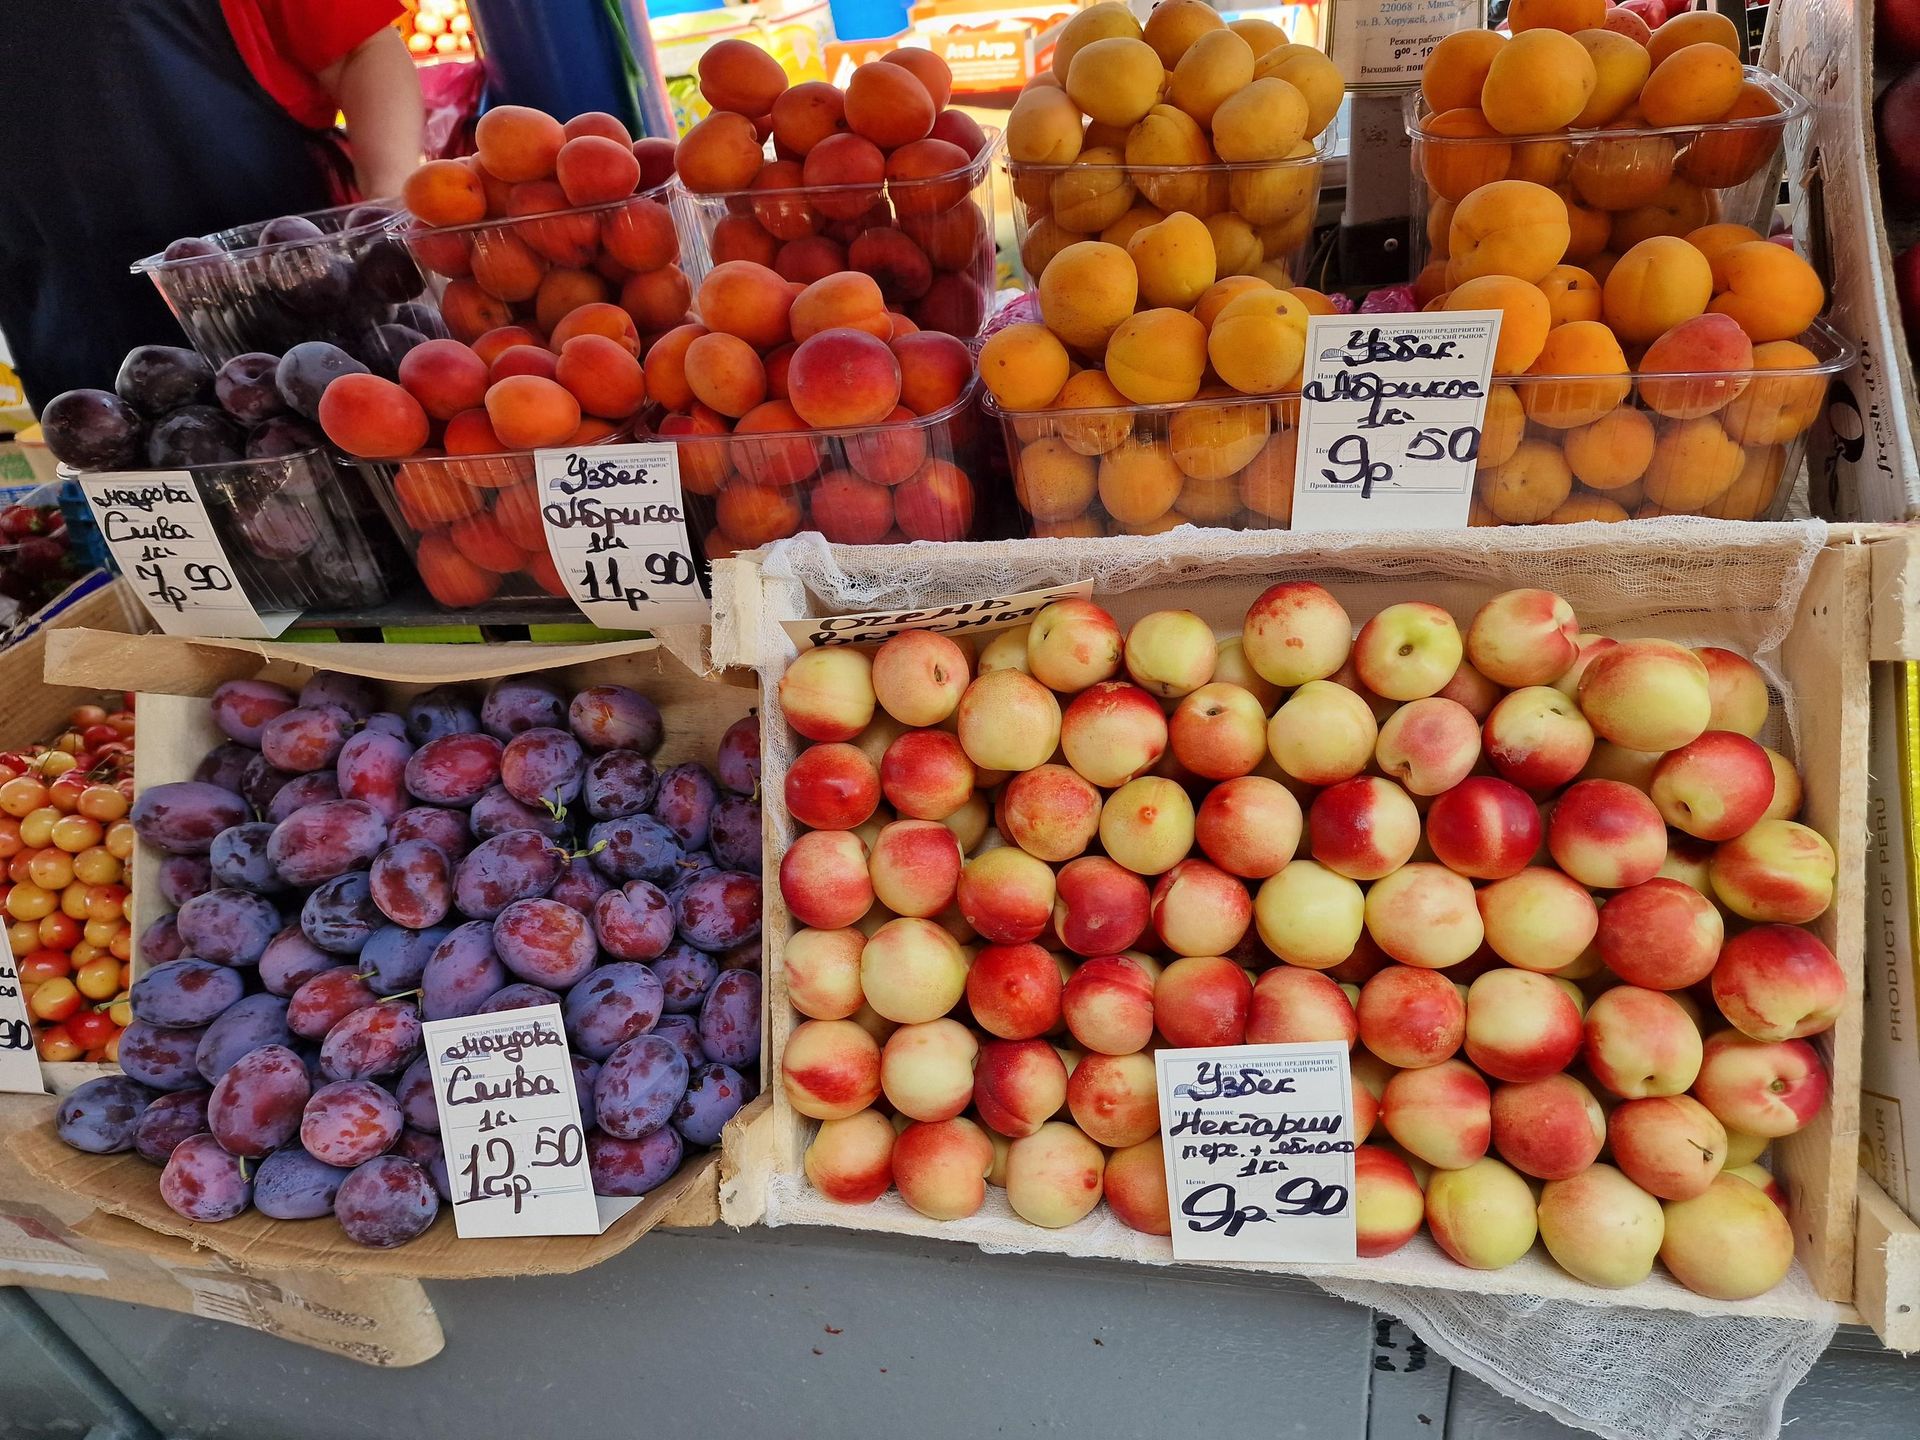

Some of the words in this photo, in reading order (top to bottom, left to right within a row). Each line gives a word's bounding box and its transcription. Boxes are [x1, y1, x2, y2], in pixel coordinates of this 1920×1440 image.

[1356, 19, 1368, 28] ул.
[1380, 3, 1412, 12] 220068
[1390, 37, 1416, 46] Режим
[1361, 65, 1404, 74] Выходной:
[1405, 426, 1482, 462] 50
[1869, 404, 1894, 479] fresh
[184, 563, 232, 590] 90
[645, 551, 696, 585] 90
[1875, 796, 1890, 864] PERU
[1880, 872, 1893, 906] OF
[1883, 914, 1902, 1042] PRODUCT
[531, 1124, 583, 1167] 50
[1275, 1177, 1348, 1215] 90
